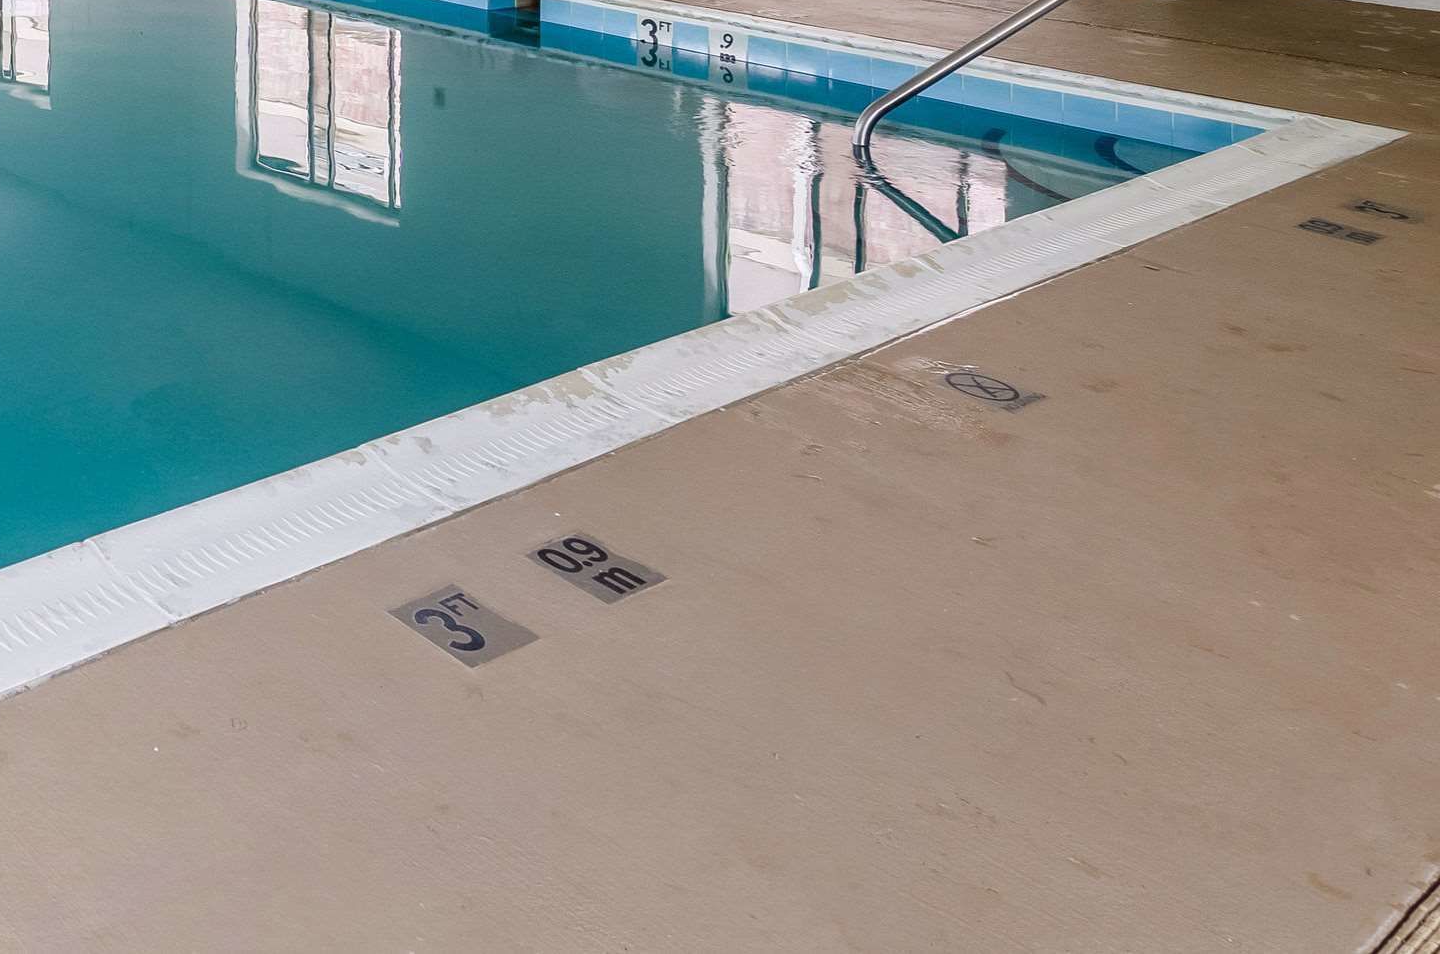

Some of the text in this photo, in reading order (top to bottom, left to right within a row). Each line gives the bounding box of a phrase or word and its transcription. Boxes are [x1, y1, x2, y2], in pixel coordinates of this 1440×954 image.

[641, 18, 672, 46] 3 FT
[536, 536, 610, 574] 0.9
[591, 566, 649, 596] m
[412, 592, 487, 653] 3 FT
